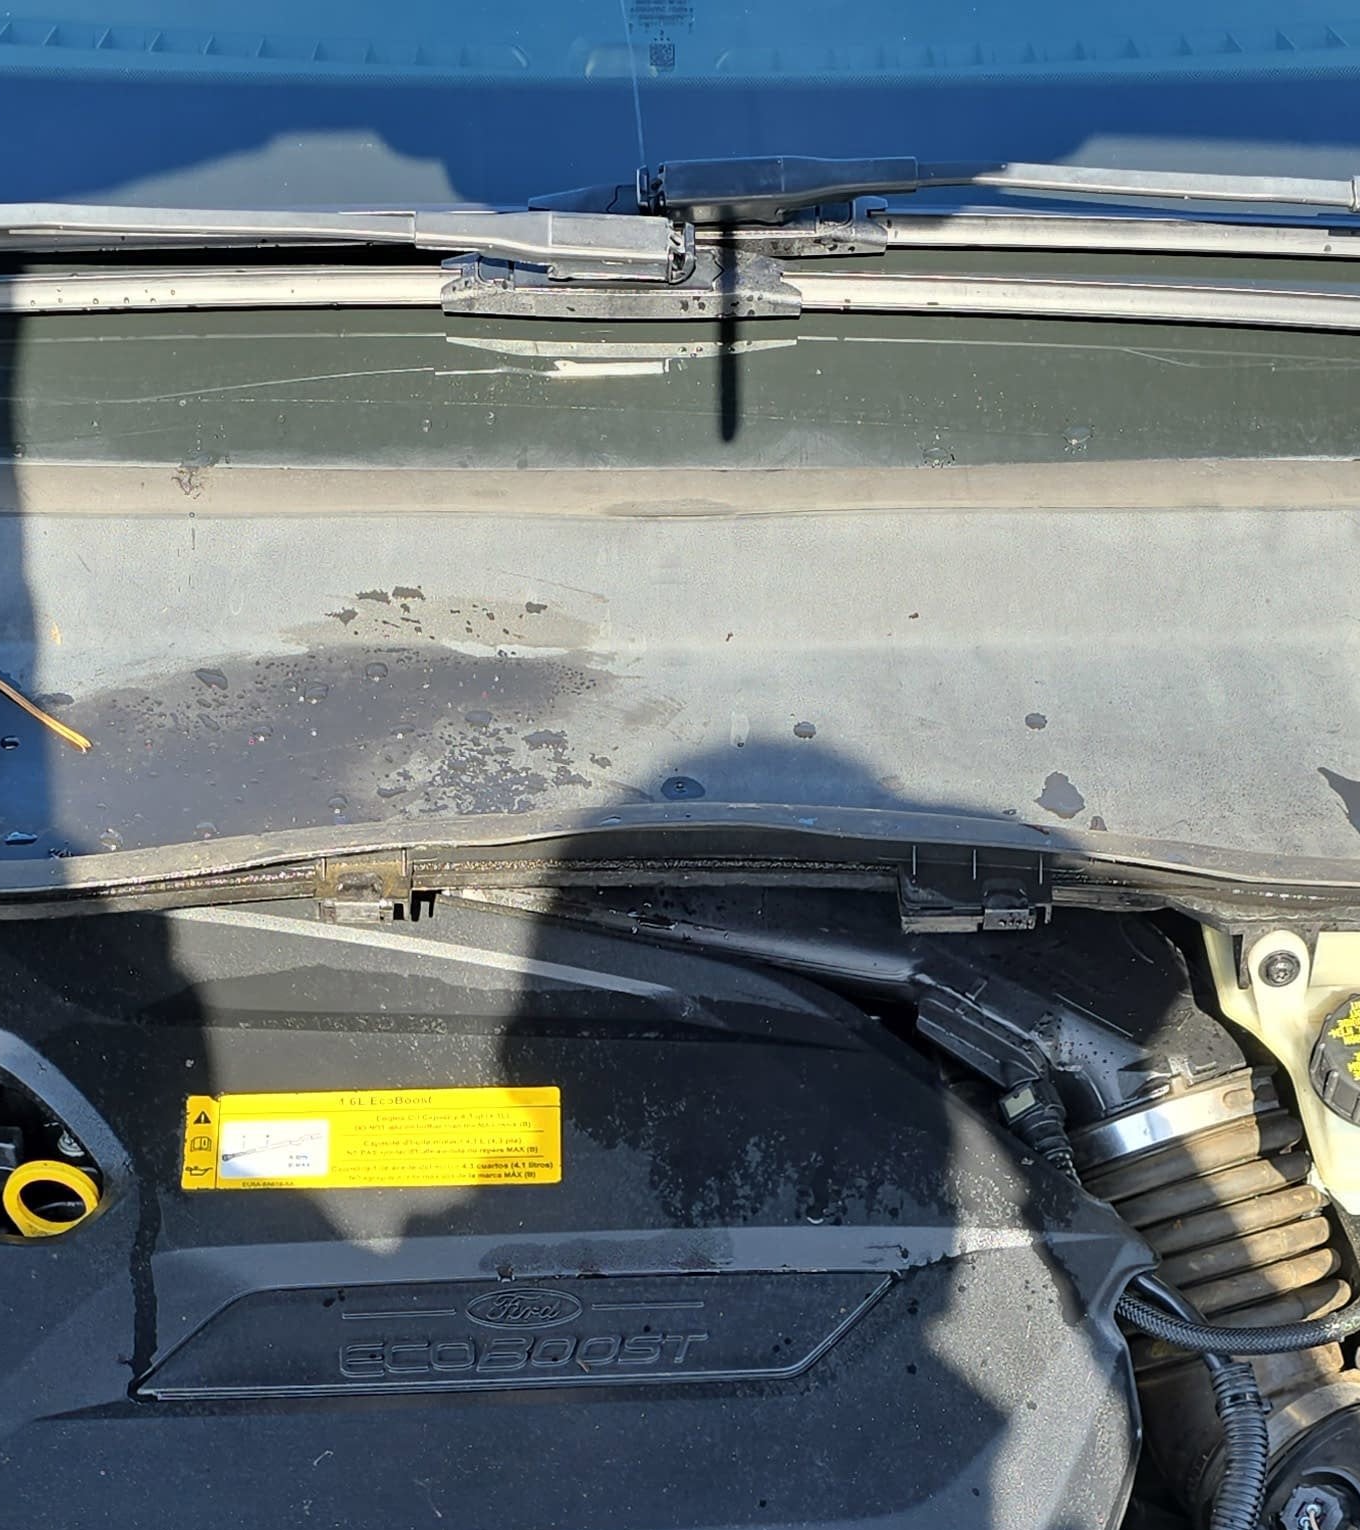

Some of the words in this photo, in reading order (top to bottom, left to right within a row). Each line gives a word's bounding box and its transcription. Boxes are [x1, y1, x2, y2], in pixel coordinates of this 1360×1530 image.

[338, 1096, 366, 1106] 16L
[485, 1292, 562, 1322] Ford
[339, 1332, 710, 1378] ECOBOOST
